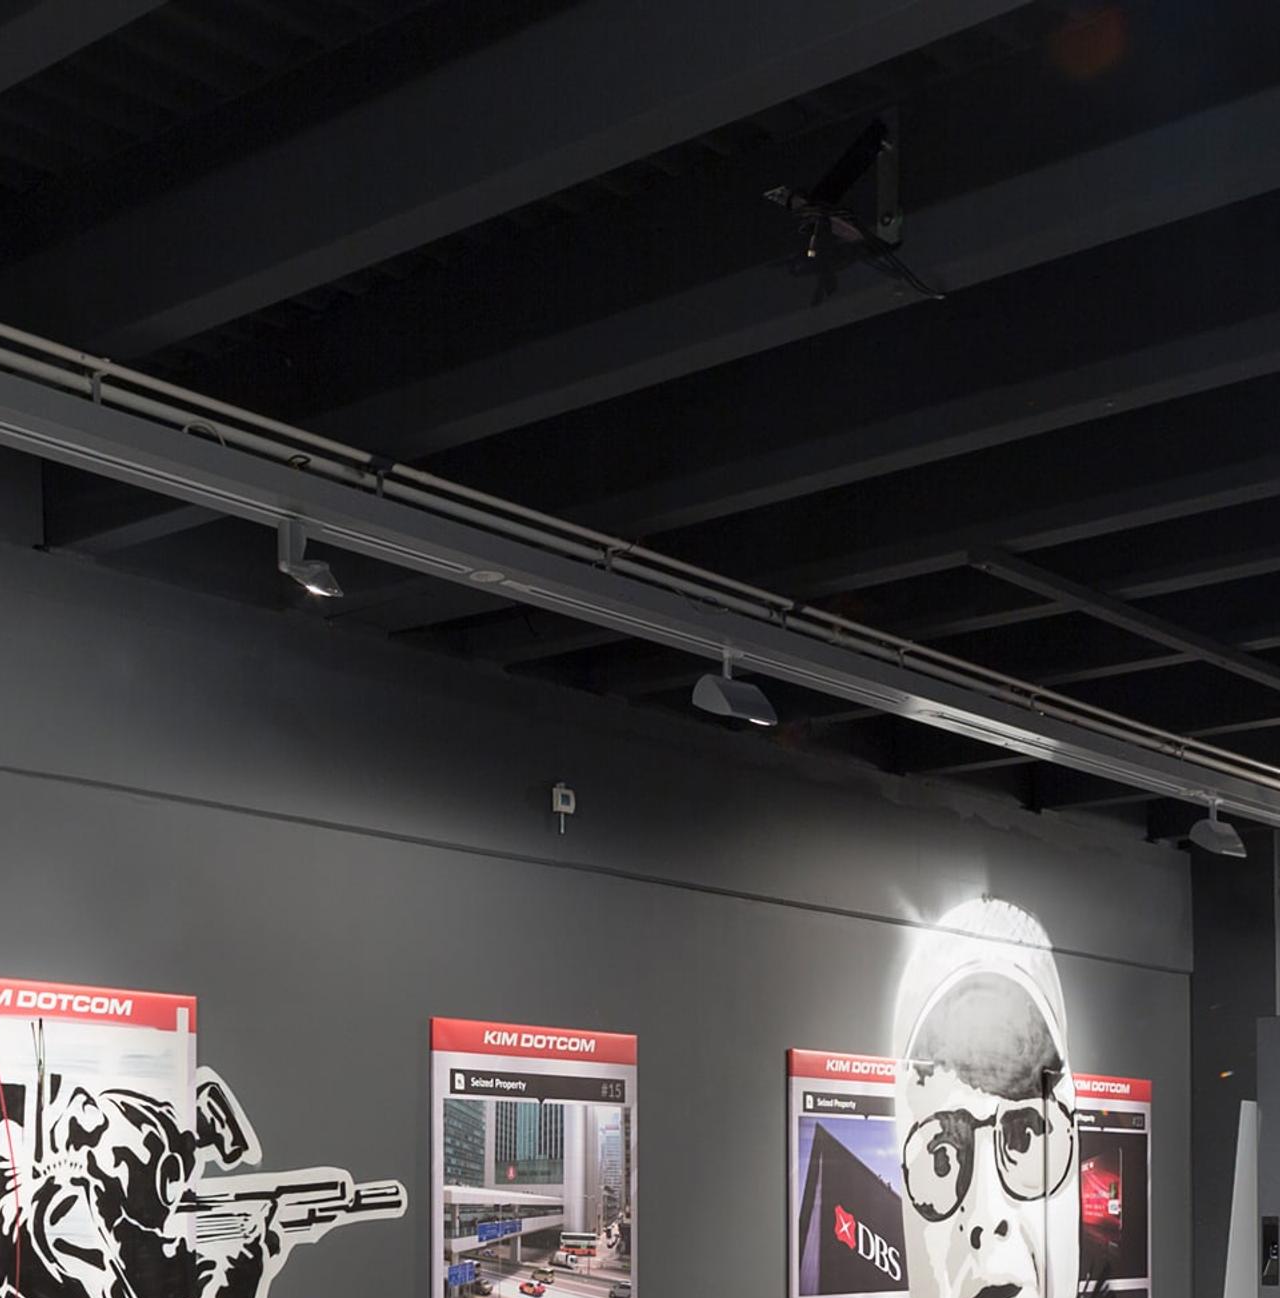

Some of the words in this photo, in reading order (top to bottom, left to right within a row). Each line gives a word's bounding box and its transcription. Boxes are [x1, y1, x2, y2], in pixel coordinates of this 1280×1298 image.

[16, 991, 133, 1016] DOTCOM
[483, 1030, 518, 1047] KIM
[520, 1034, 596, 1053] DOTCOM
[826, 1059, 850, 1073] KIM
[852, 1061, 896, 1076] DOTCO
[470, 1077, 494, 1089] Seized
[495, 1078, 527, 1091] Property
[601, 1083, 622, 1098] #15
[1091, 1080, 1130, 1094] DOTCOM
[857, 1221, 901, 1281] DBS
